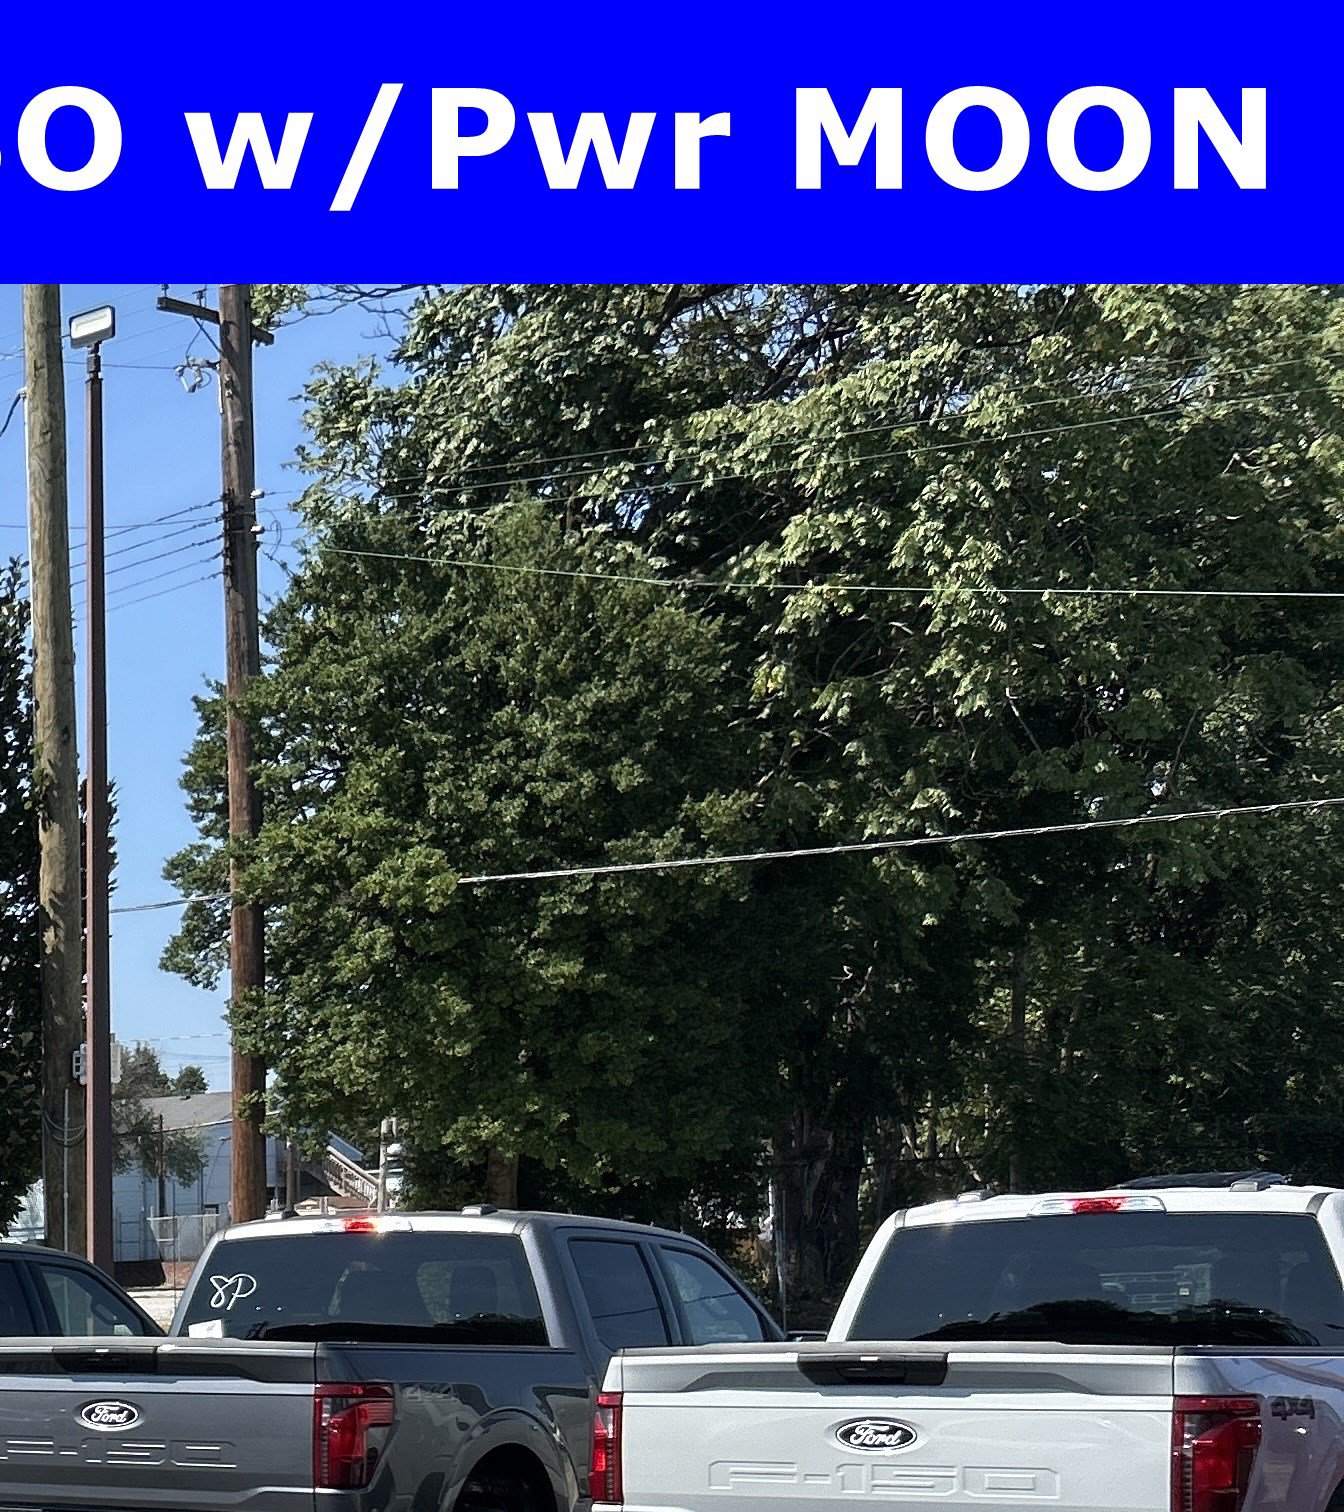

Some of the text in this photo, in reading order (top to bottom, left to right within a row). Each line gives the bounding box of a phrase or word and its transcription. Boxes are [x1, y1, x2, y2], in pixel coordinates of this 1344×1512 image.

[90, 1404, 127, 1424] Ford
[849, 1423, 902, 1446] Ford
[708, 1460, 1061, 1500] F-150
